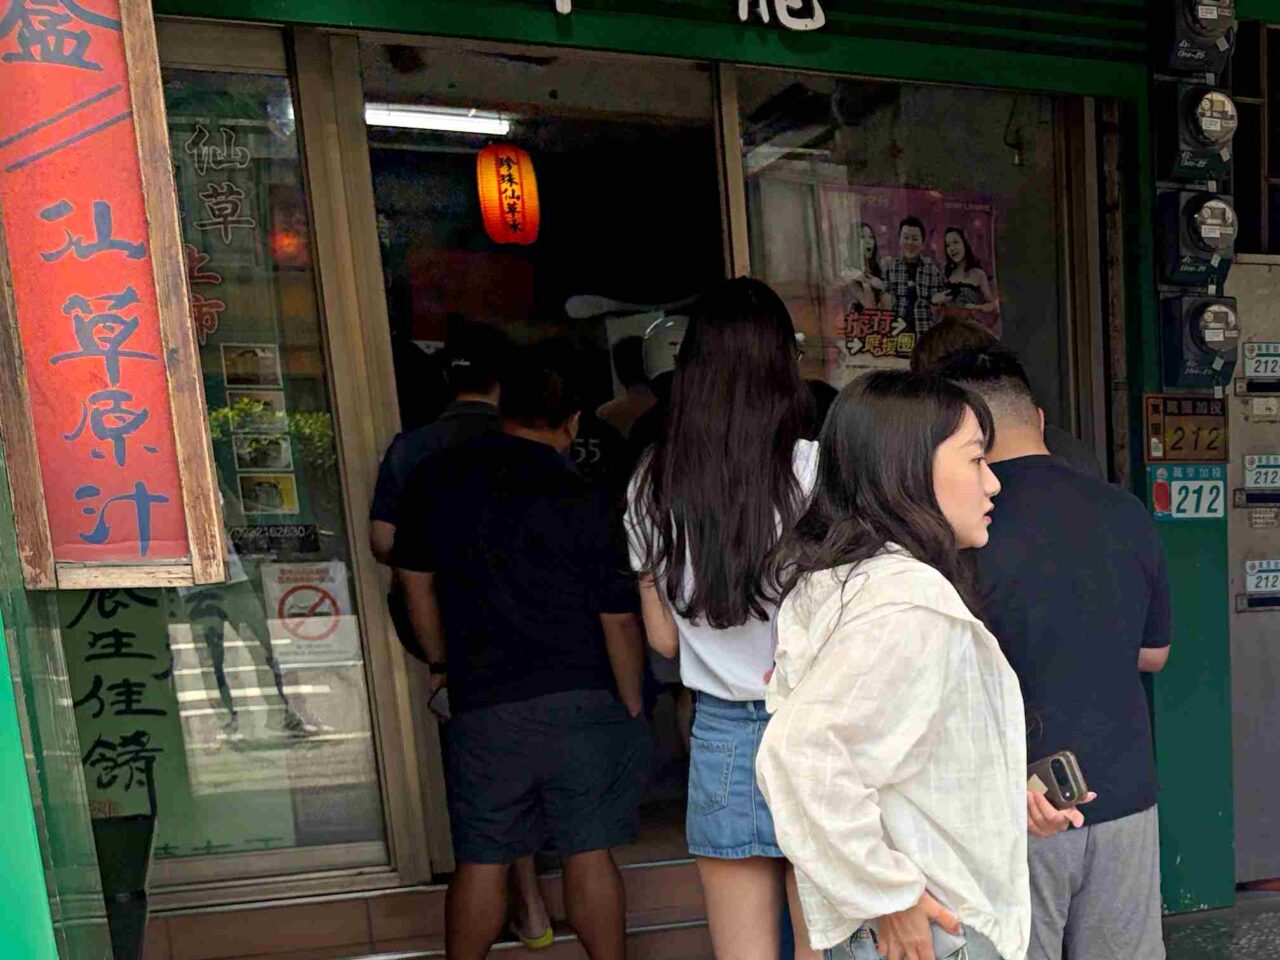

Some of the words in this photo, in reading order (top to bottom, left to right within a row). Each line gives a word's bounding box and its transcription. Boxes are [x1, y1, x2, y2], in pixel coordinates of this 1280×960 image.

[185, 122, 255, 243] 仙草
[1254, 359, 1278, 374] 212
[1171, 426, 1221, 452] 212
[1254, 470, 1278, 484] 212
[1176, 485, 1220, 513] 212
[1255, 575, 1279, 589] 212
